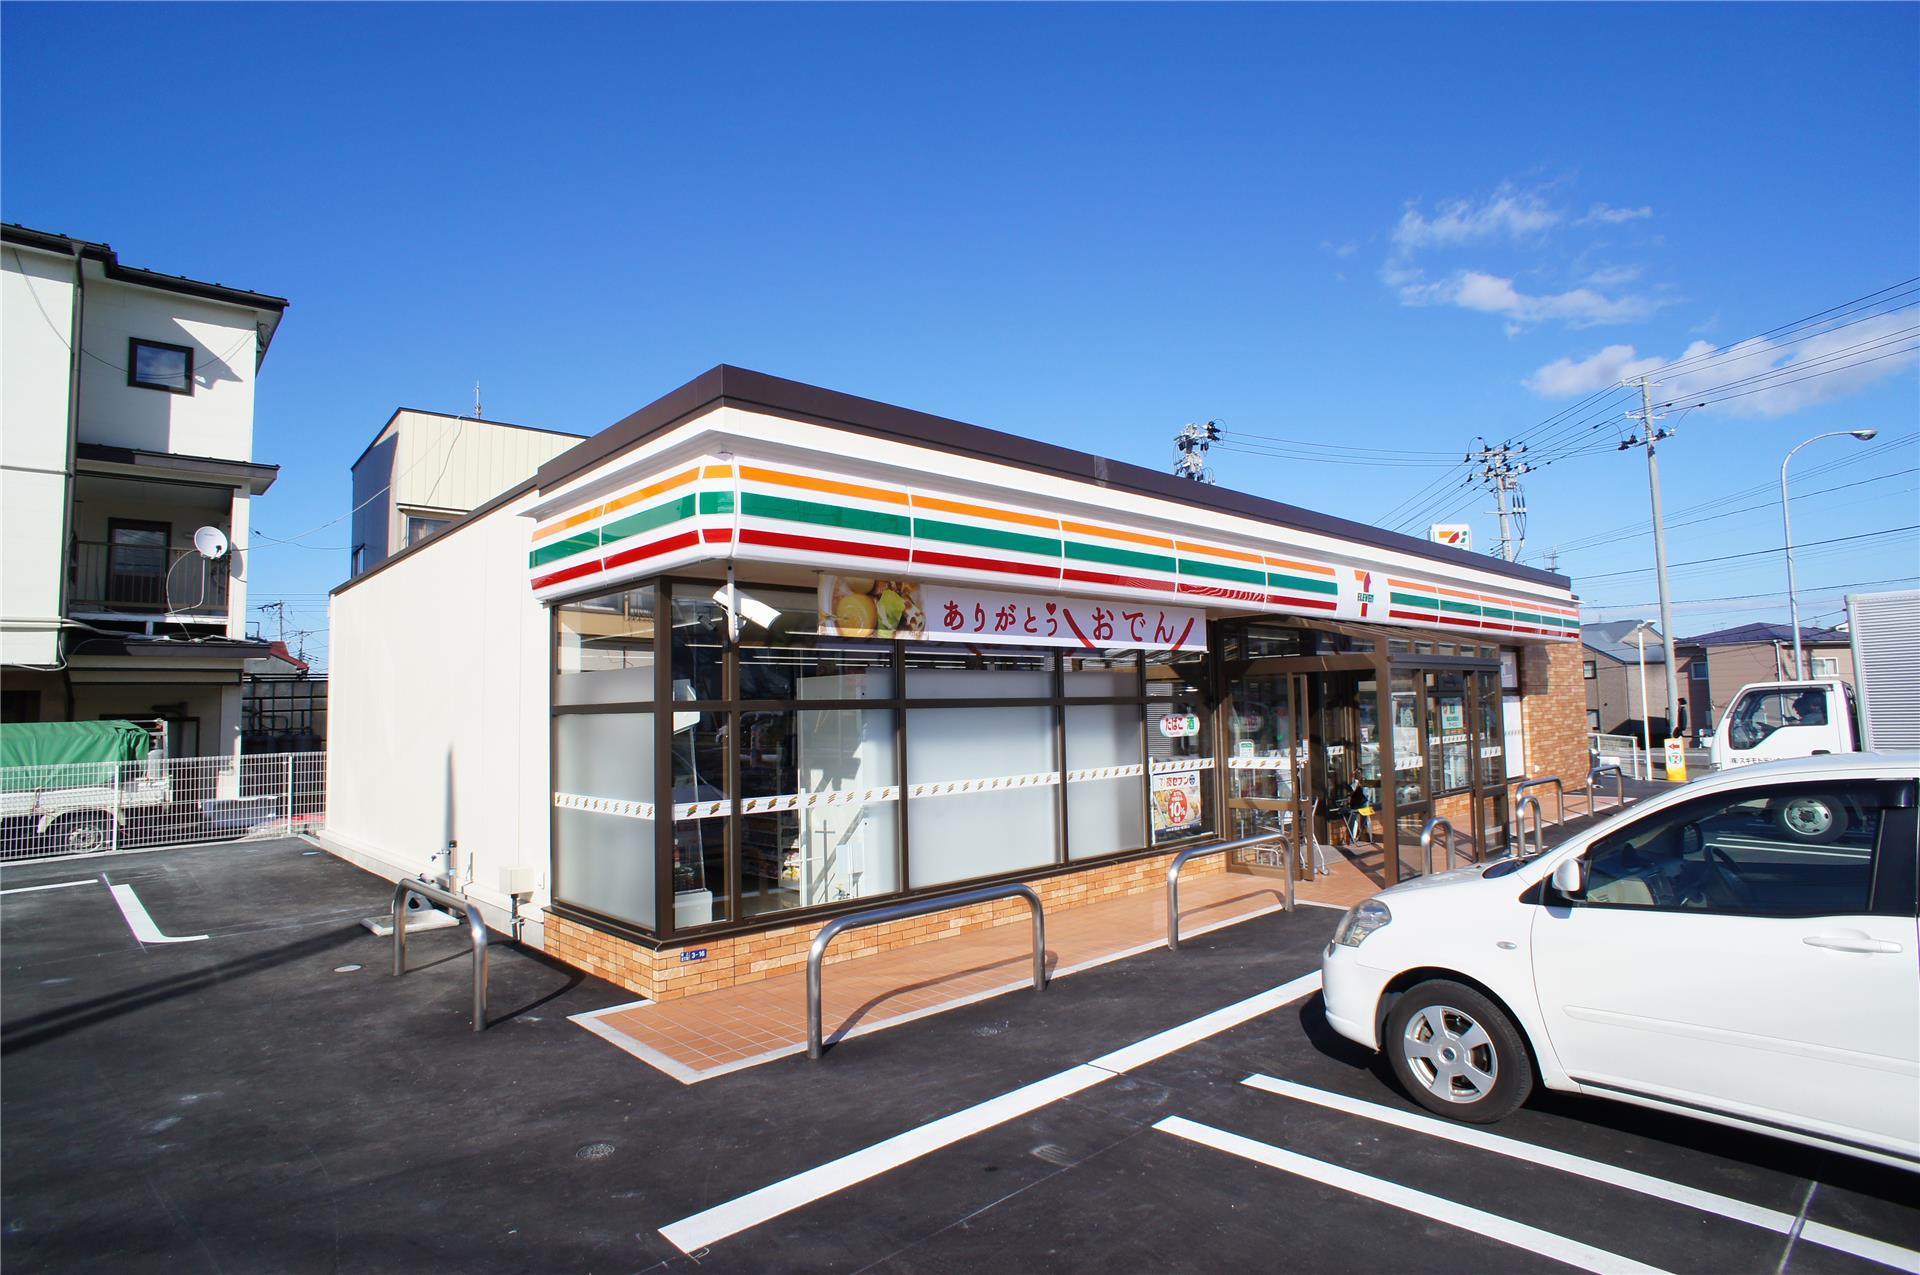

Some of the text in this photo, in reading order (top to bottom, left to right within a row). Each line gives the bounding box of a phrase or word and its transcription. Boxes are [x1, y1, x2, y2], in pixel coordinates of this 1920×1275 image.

[943, 600, 1175, 644] ありがとう おでん
[1165, 716, 1195, 731] たばこ 酒
[1169, 801, 1186, 818] 10%
